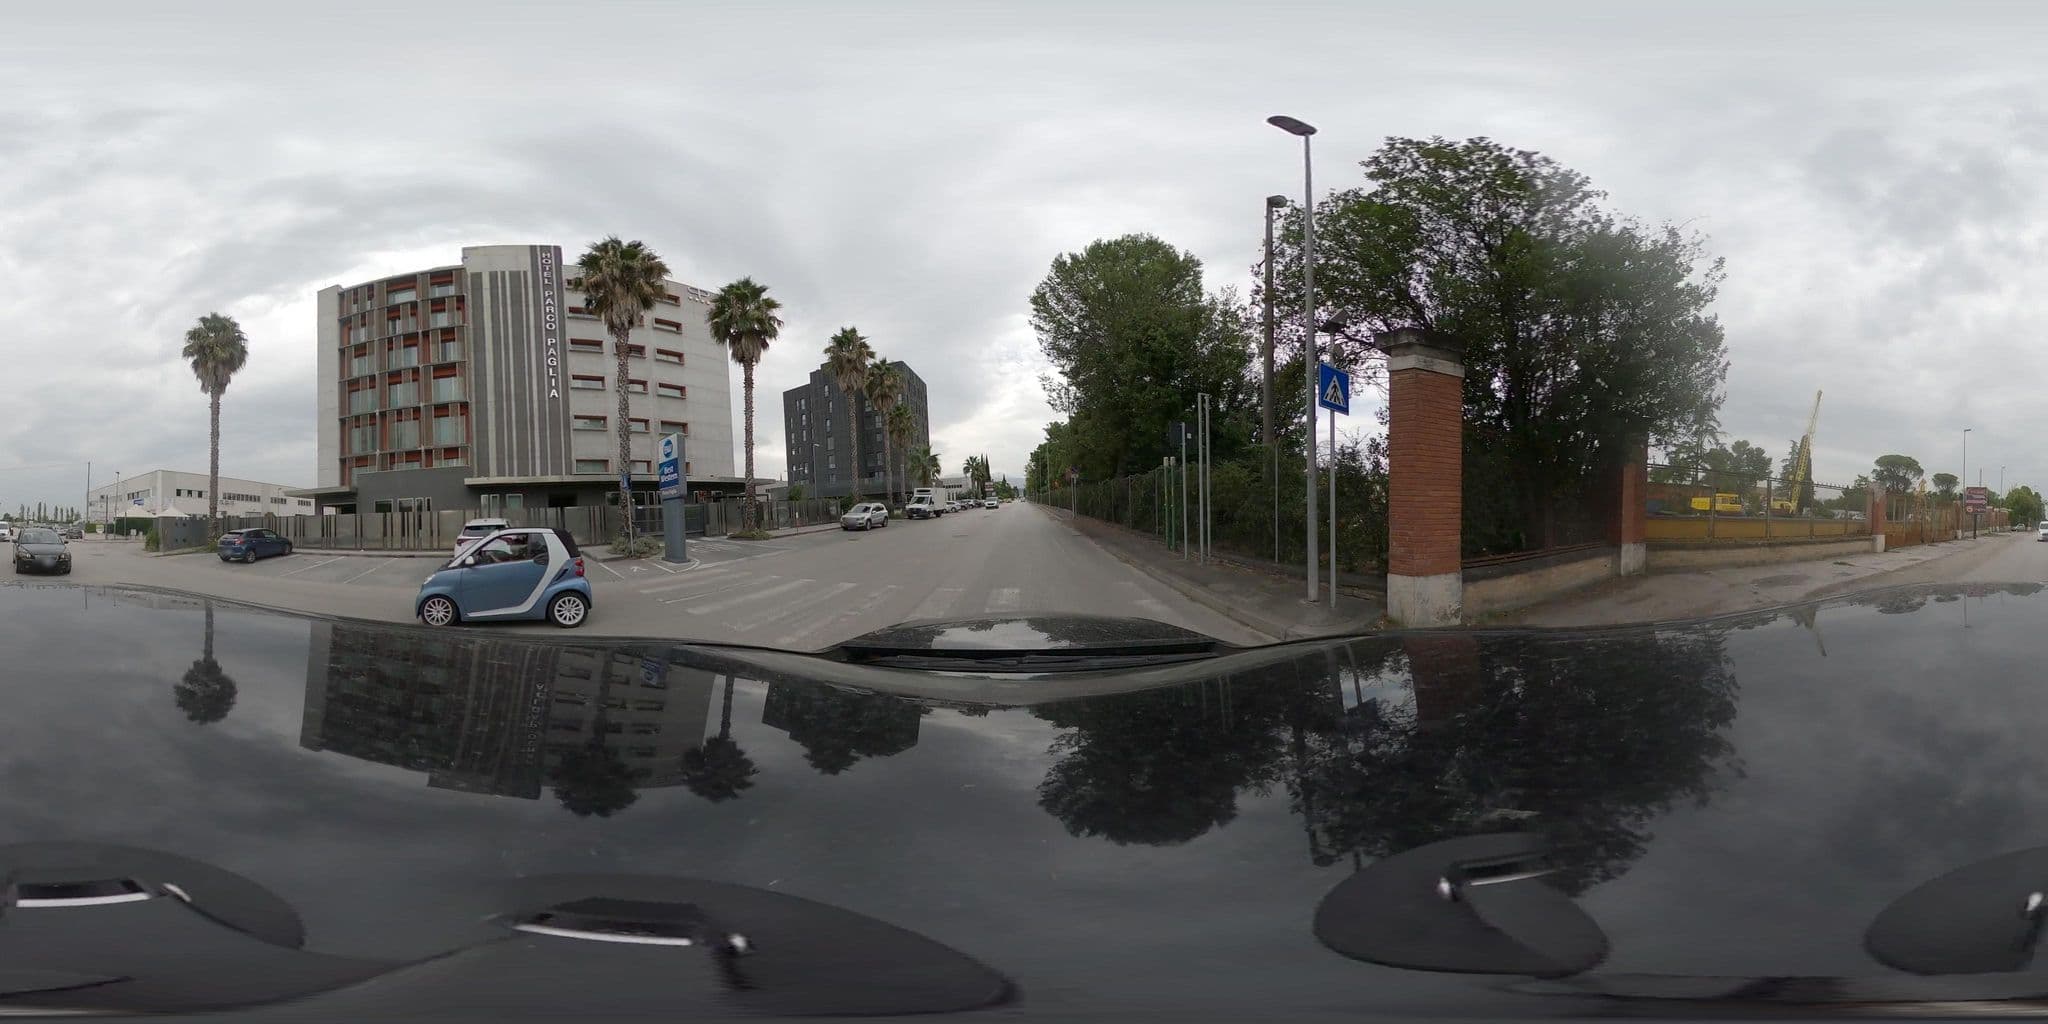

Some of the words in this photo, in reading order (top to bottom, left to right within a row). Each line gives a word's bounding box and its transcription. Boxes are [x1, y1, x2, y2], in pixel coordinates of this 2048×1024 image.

[542, 252, 552, 285] HOTEL
[544, 291, 556, 330] PARCO
[547, 338, 559, 398] PAGLIA
